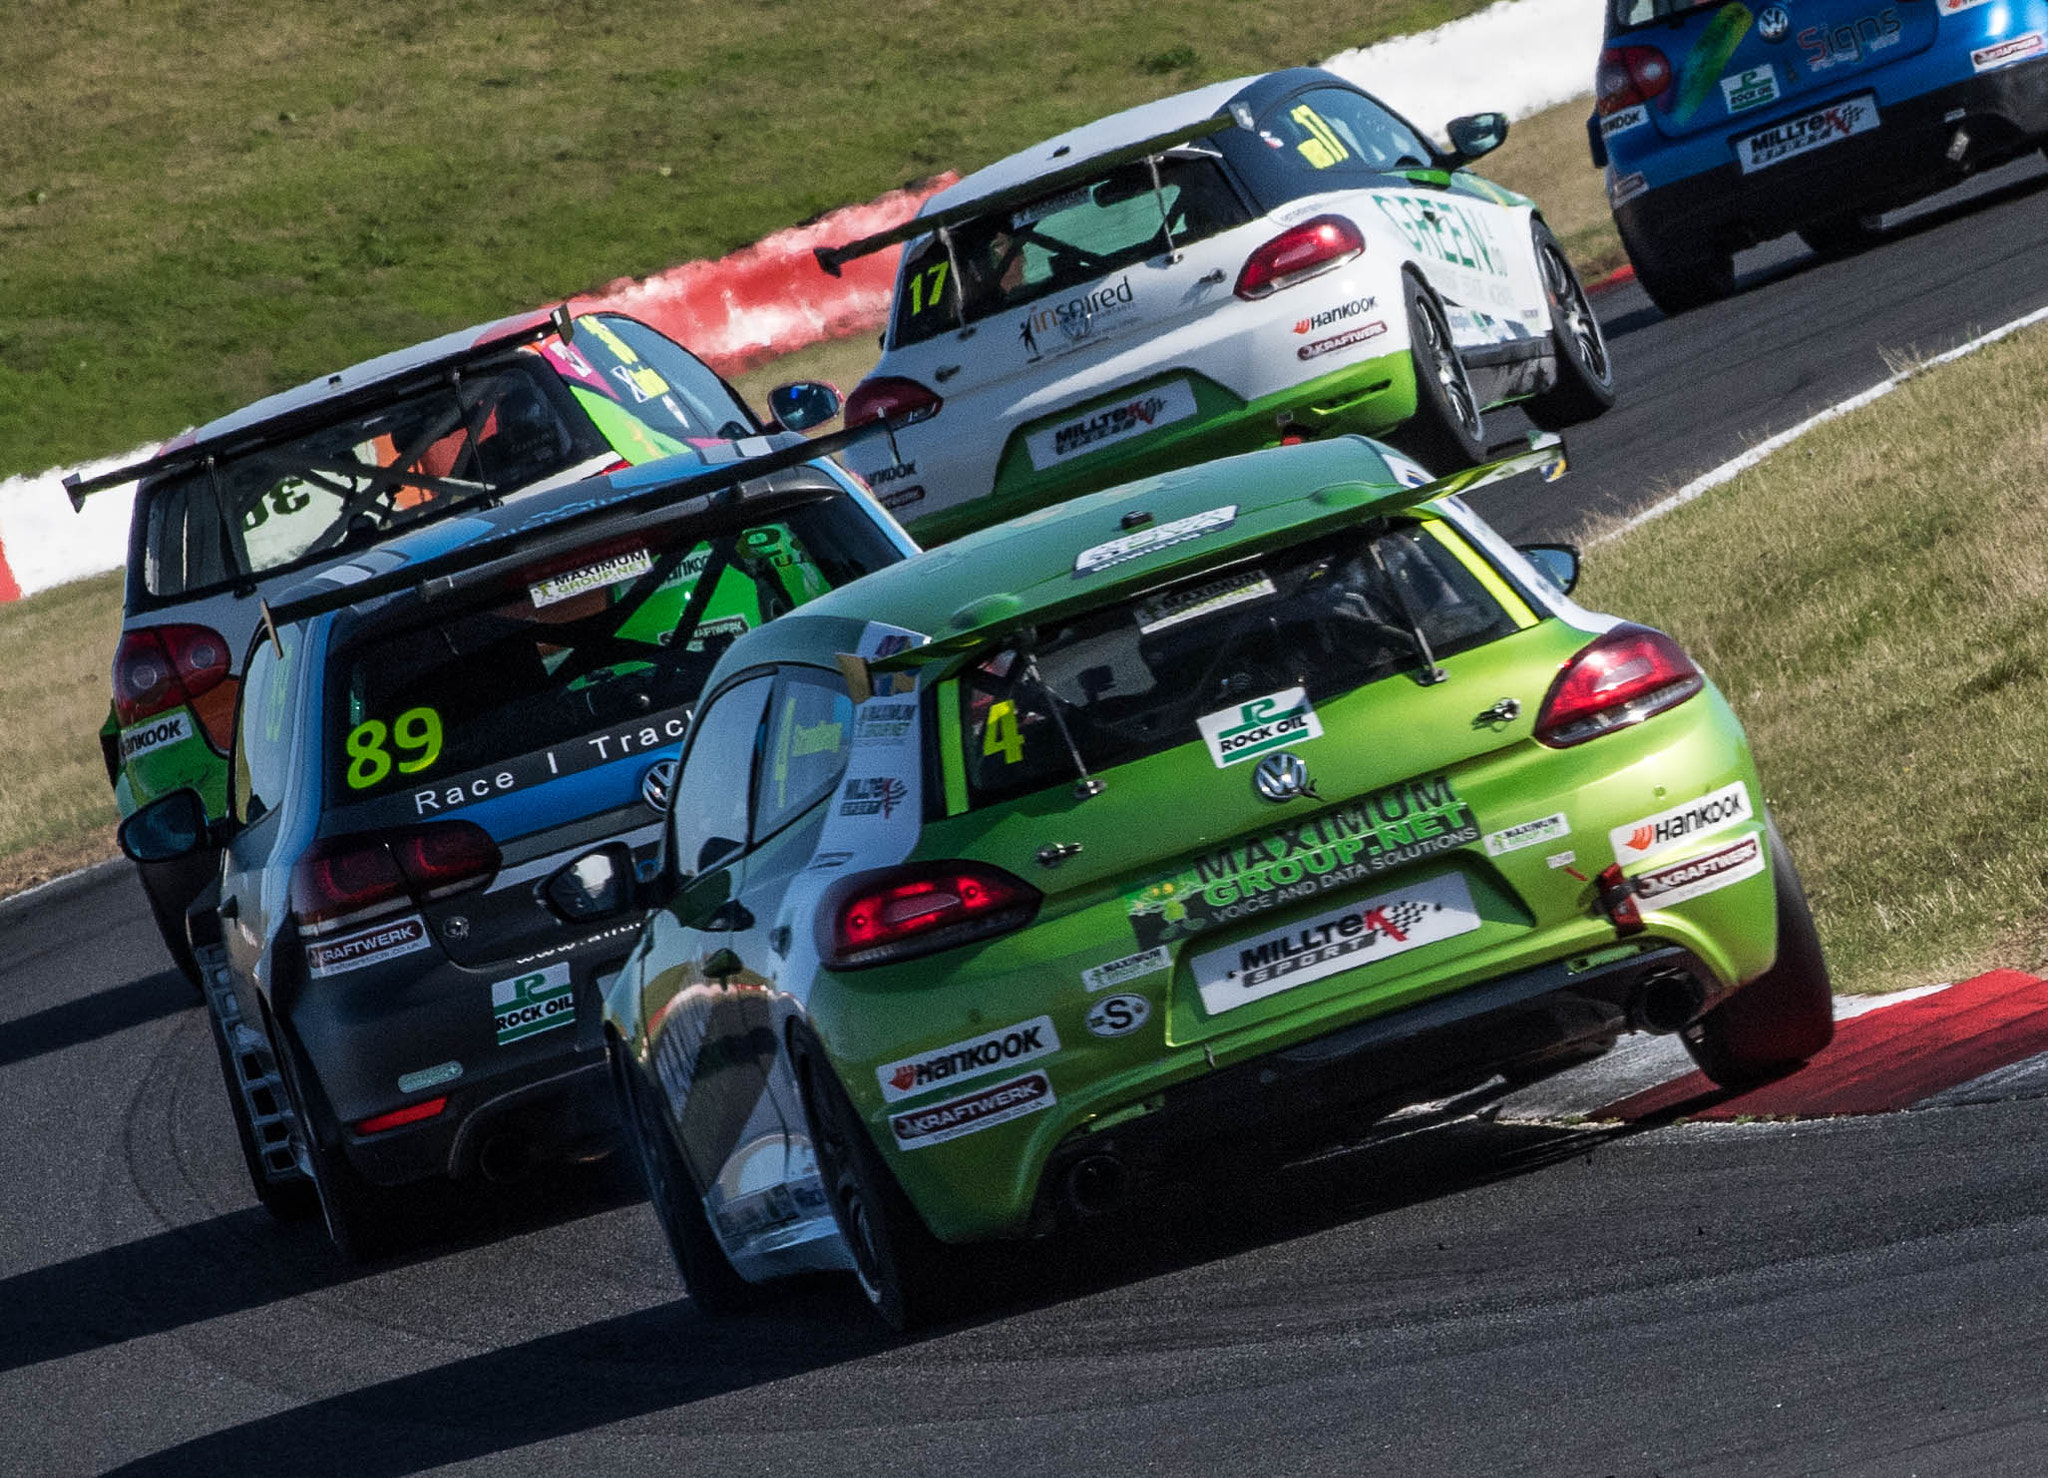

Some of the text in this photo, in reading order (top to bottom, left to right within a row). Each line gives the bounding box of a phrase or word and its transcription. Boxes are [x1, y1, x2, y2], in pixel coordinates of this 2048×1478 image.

[1798, 8, 1901, 62] Signs
[910, 261, 949, 316] 17
[553, 548, 647, 586] MAXIMUM
[558, 561, 649, 593] GROUP.NET
[346, 707, 443, 789] 89
[983, 699, 1025, 765] 4
[1220, 716, 1308, 753] ROCK OIL
[414, 771, 515, 815] Race
[1194, 775, 1457, 884] MAXIMUM
[1204, 803, 1467, 907] GROUP.NET
[1212, 894, 1274, 922] VOICE
[1277, 880, 1318, 903] AND
[1320, 863, 1371, 888] DATA
[1371, 827, 1478, 871] SOLUTIONS
[319, 925, 417, 963] KRAFTWERK
[1251, 937, 1363, 984] SPORT
[495, 996, 574, 1032] ROCK OIL
[1105, 999, 1134, 1029] S
[914, 1081, 1040, 1131] KRAFTWERK
